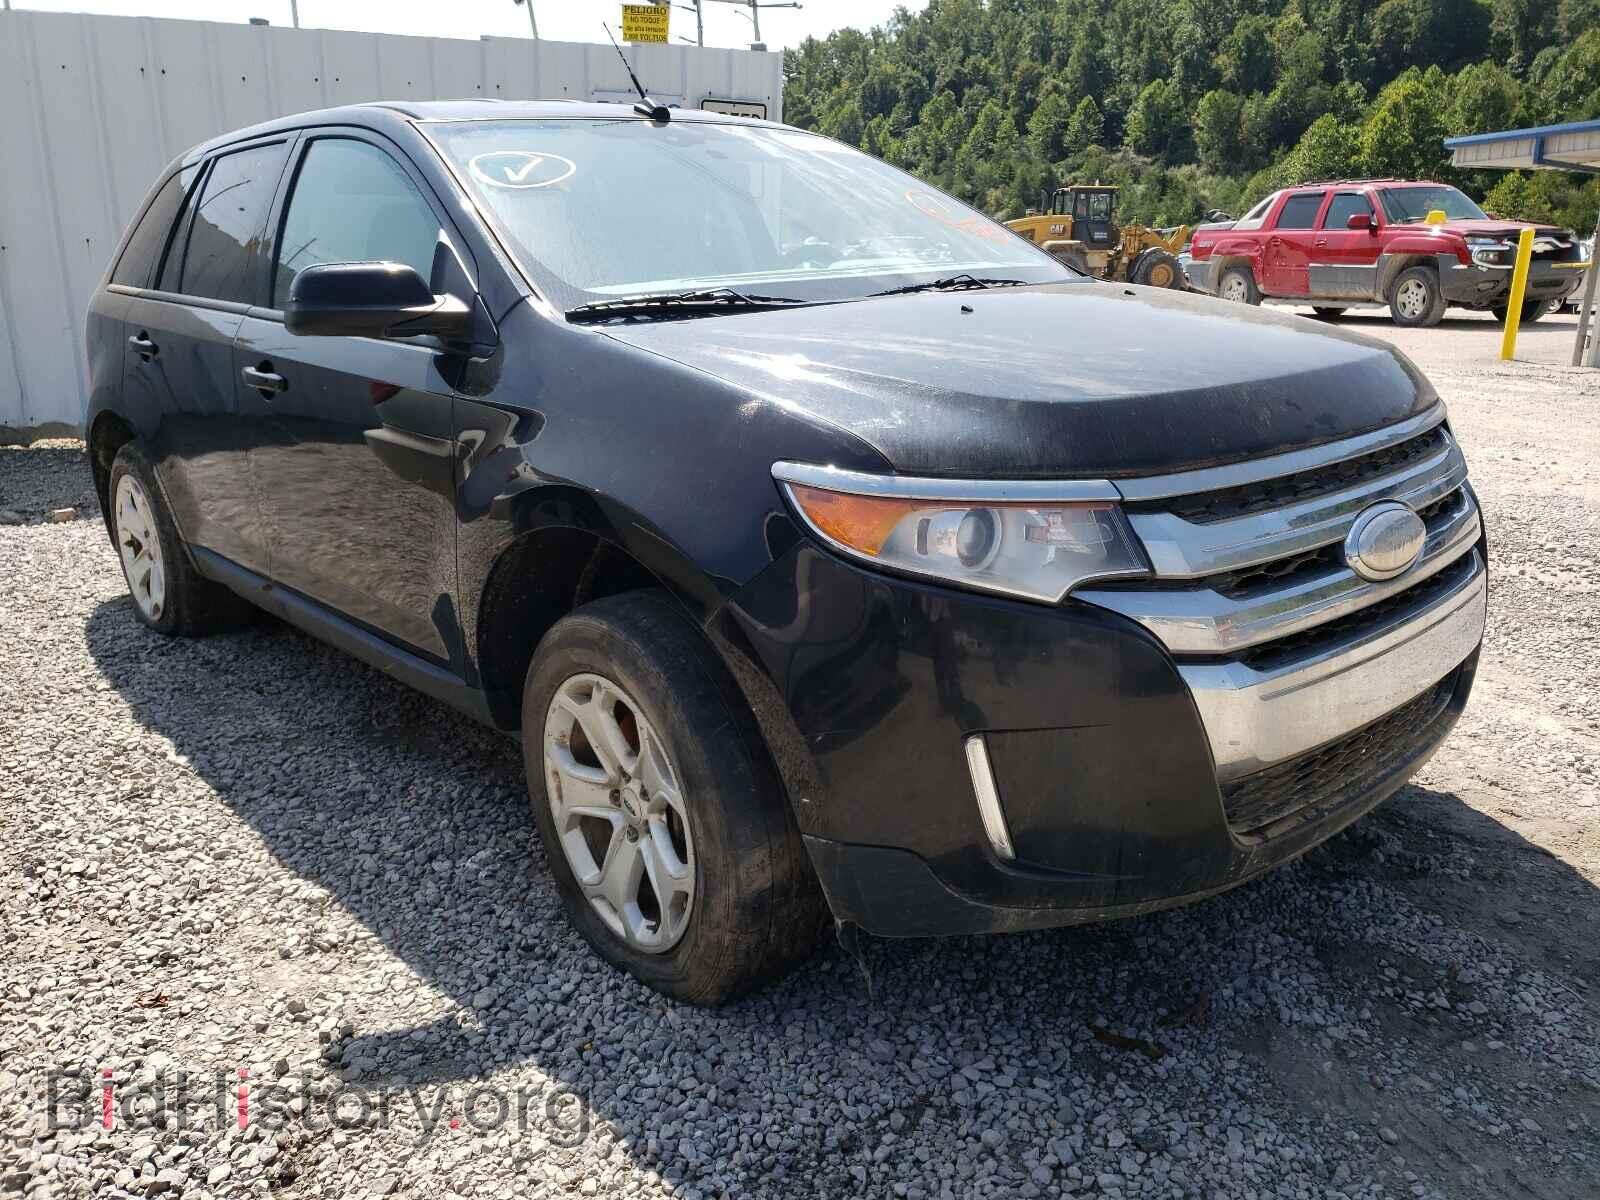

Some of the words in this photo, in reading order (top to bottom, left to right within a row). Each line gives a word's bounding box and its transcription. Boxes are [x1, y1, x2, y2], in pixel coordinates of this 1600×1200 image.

[624, 5, 667, 16] PELIGRO
[640, 16, 660, 24] TOQUE
[1050, 224, 1064, 233] CAT
